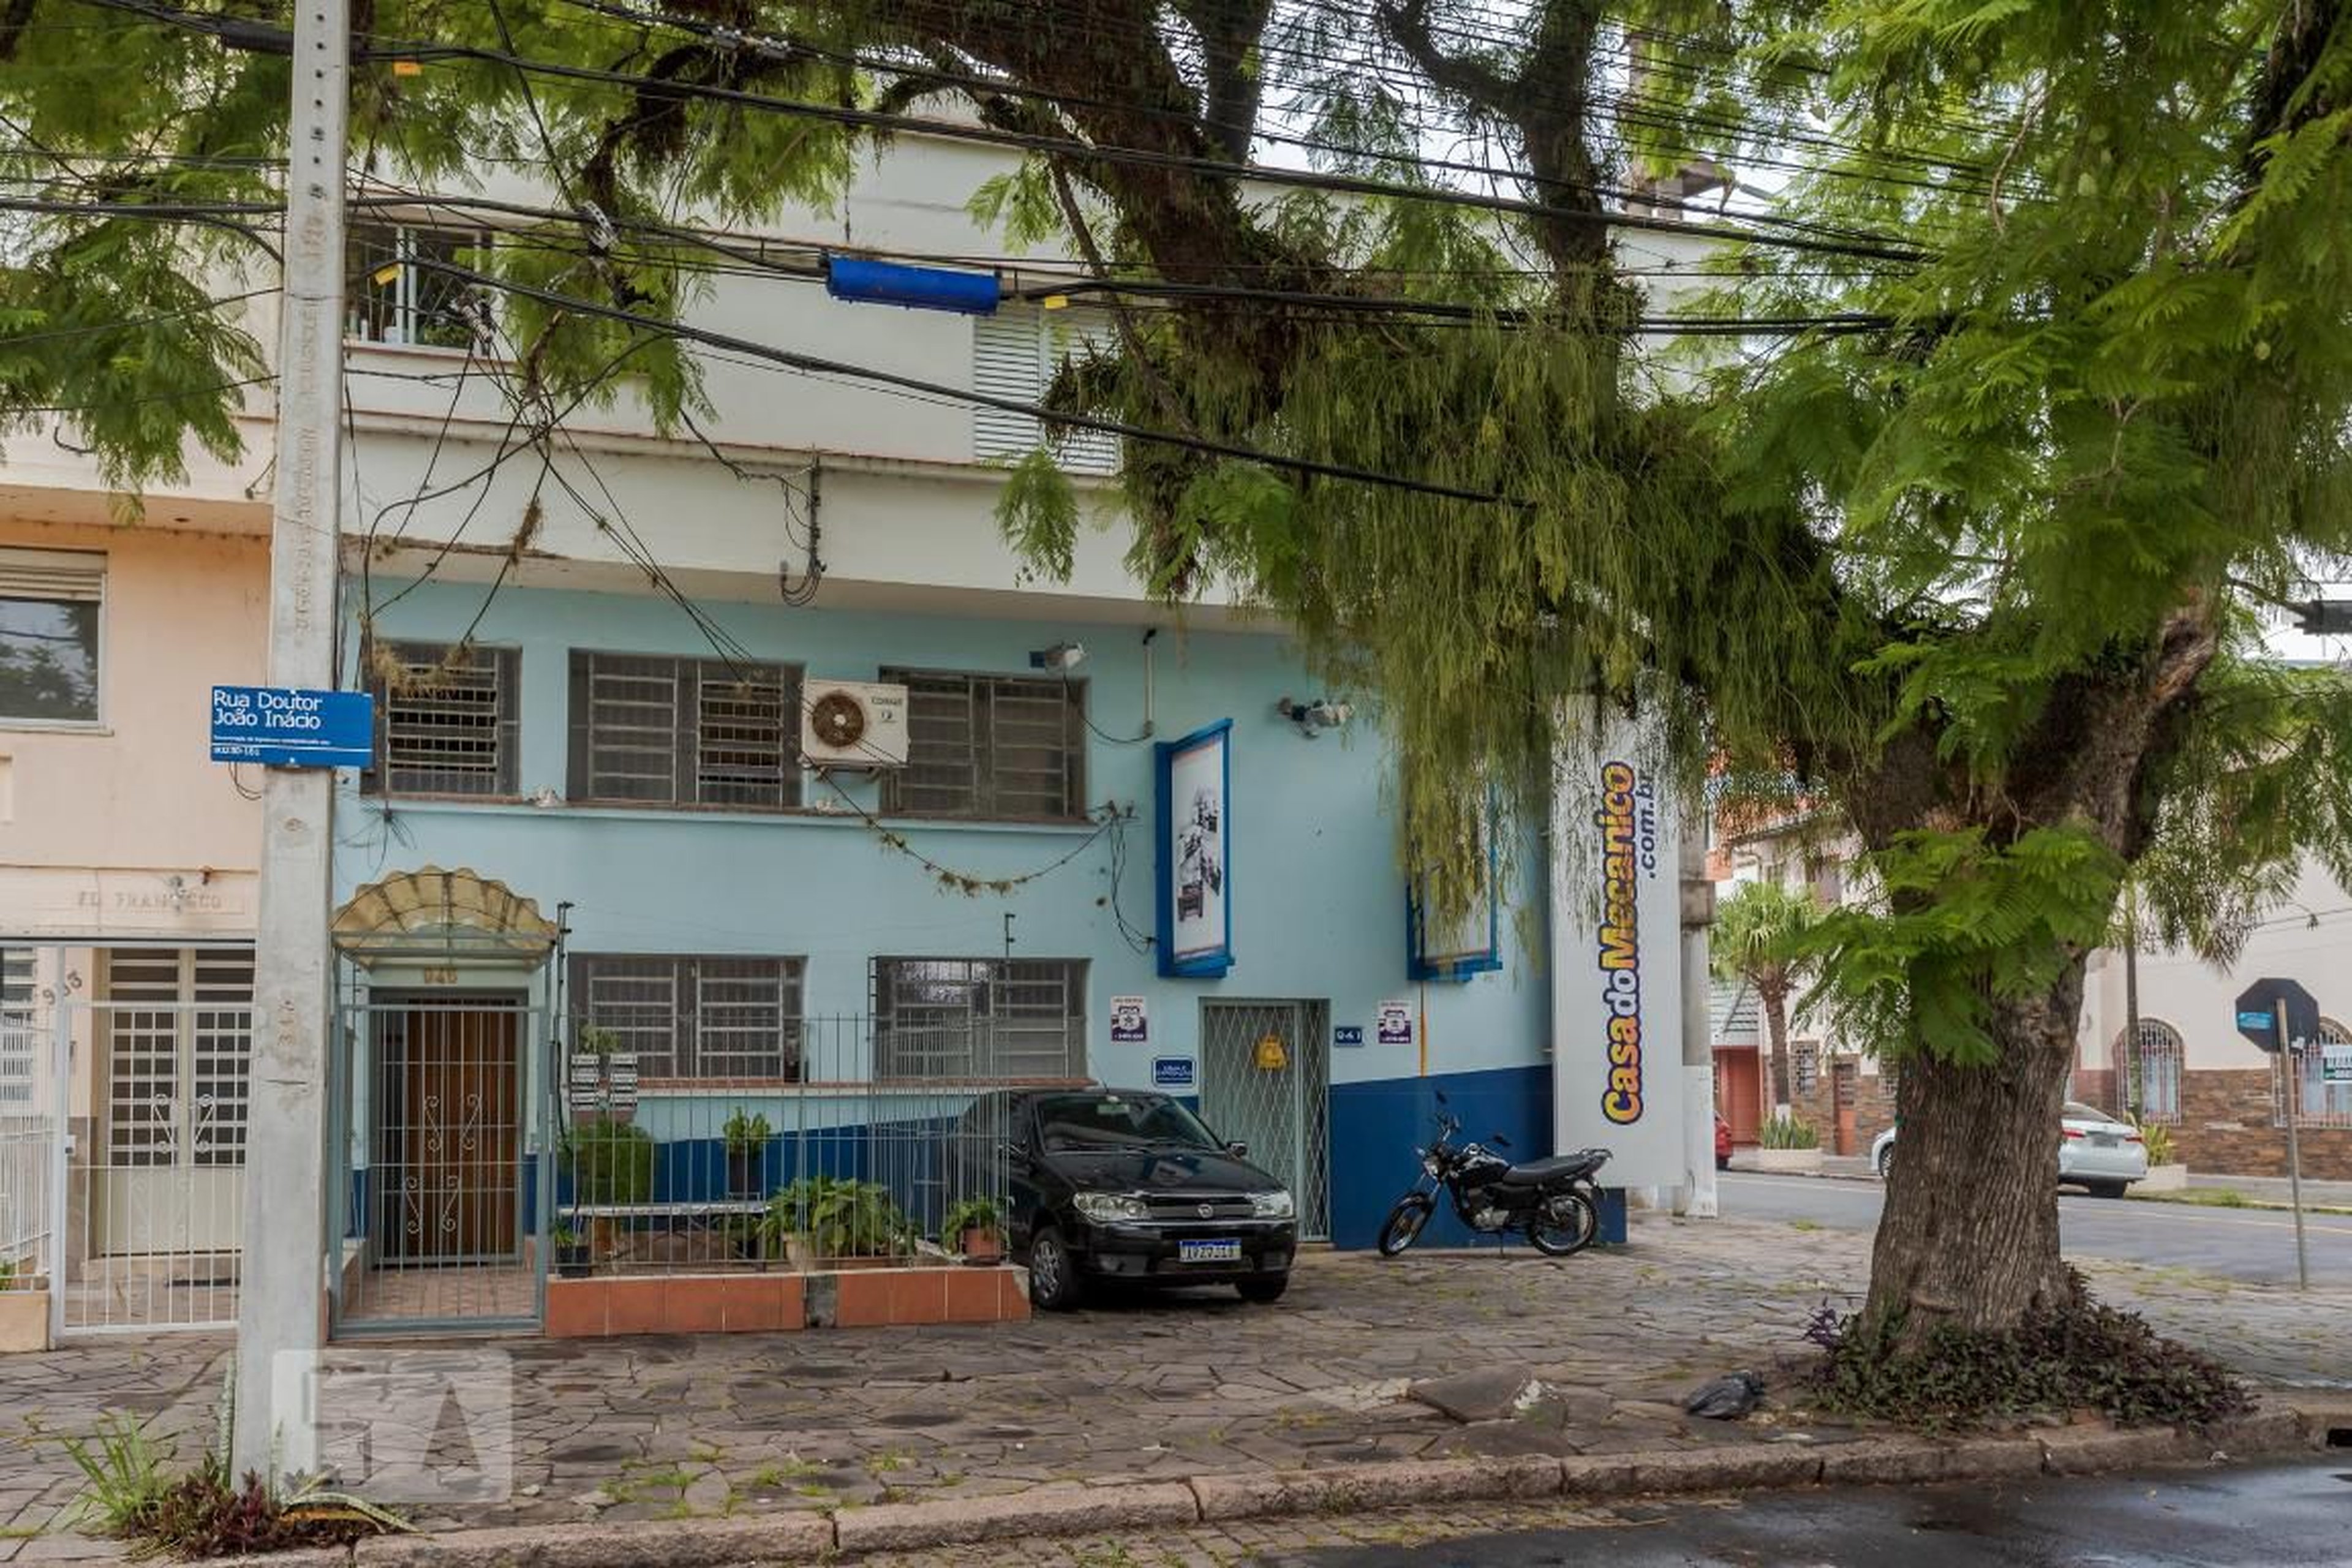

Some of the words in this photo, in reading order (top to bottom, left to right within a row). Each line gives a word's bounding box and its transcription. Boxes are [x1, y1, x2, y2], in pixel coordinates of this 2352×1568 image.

[214, 690, 250, 707] Rua
[258, 692, 323, 711] Doutor
[214, 708, 258, 726] João
[265, 710, 321, 729] Inácio
